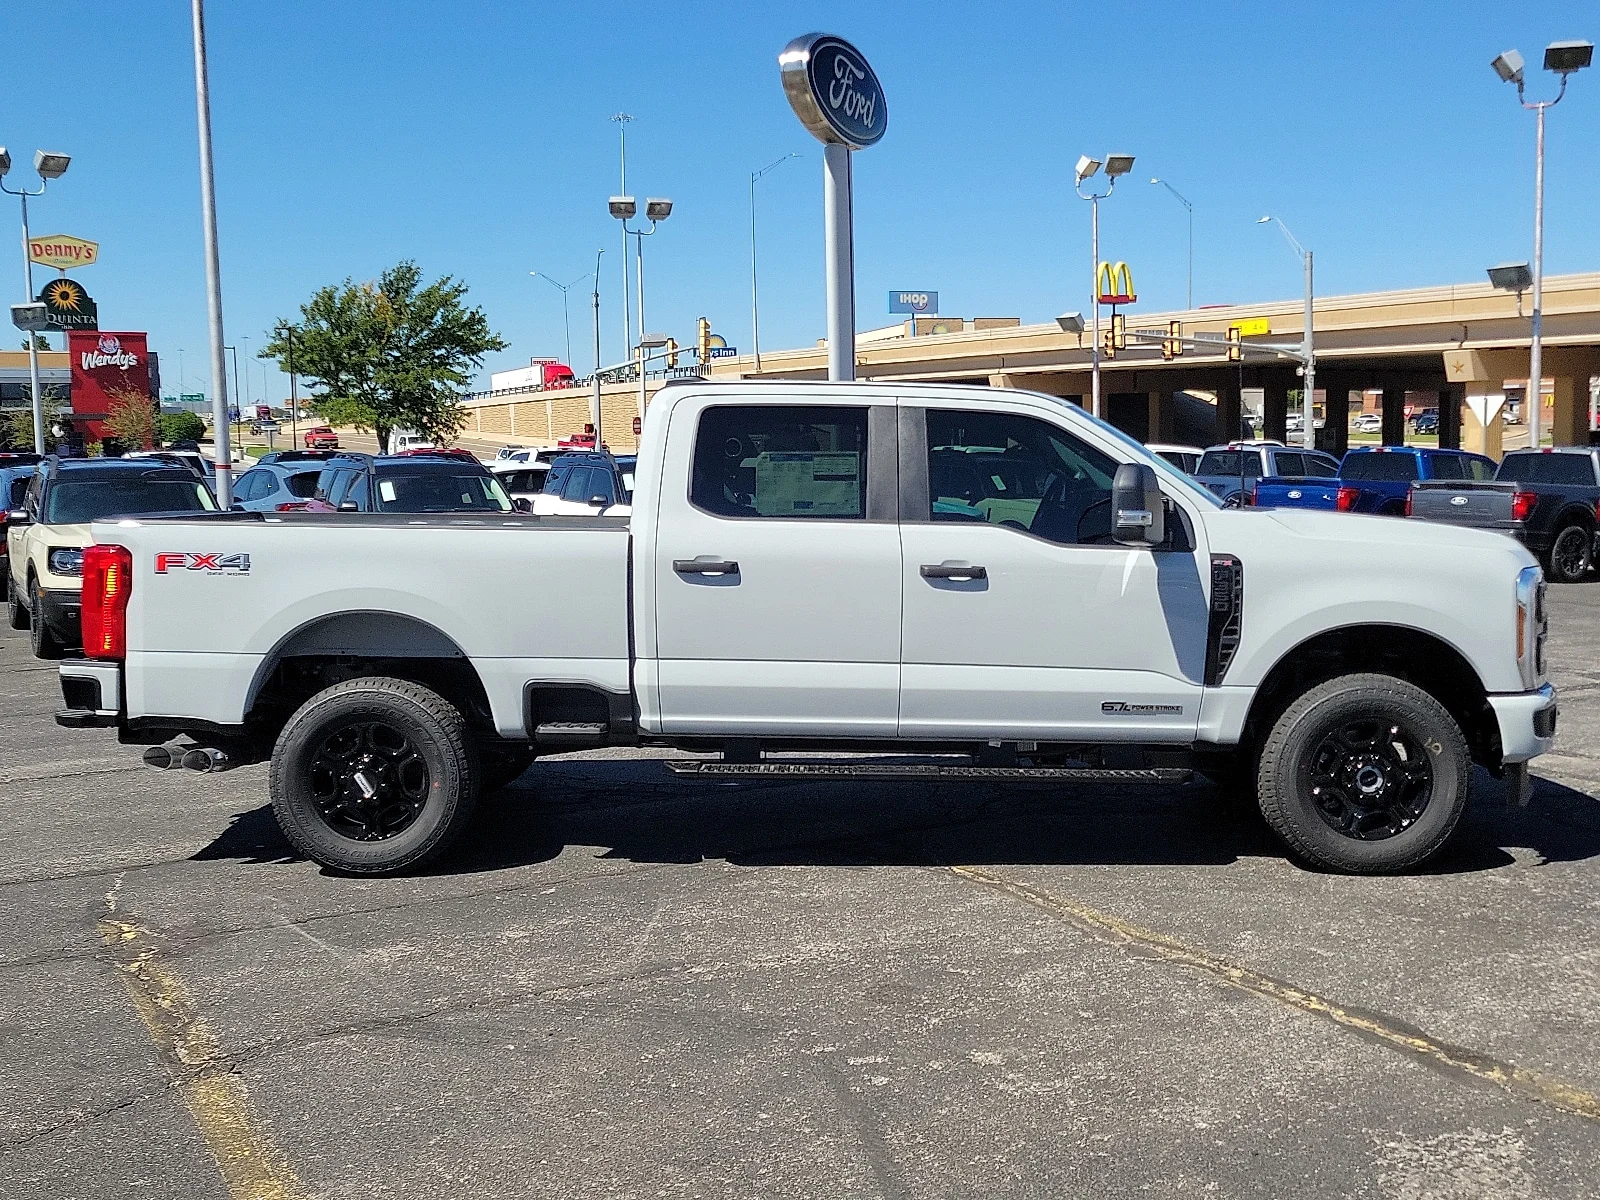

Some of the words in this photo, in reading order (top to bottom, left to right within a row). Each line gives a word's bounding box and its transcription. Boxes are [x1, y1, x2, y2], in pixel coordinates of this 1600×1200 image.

[829, 54, 876, 128] Ford
[31, 243, 93, 260] Denny's
[47, 313, 97, 325] QUINTA
[81, 349, 138, 370] Wendy's
[720, 348, 735, 356] Inn
[154, 552, 251, 574] FX4
